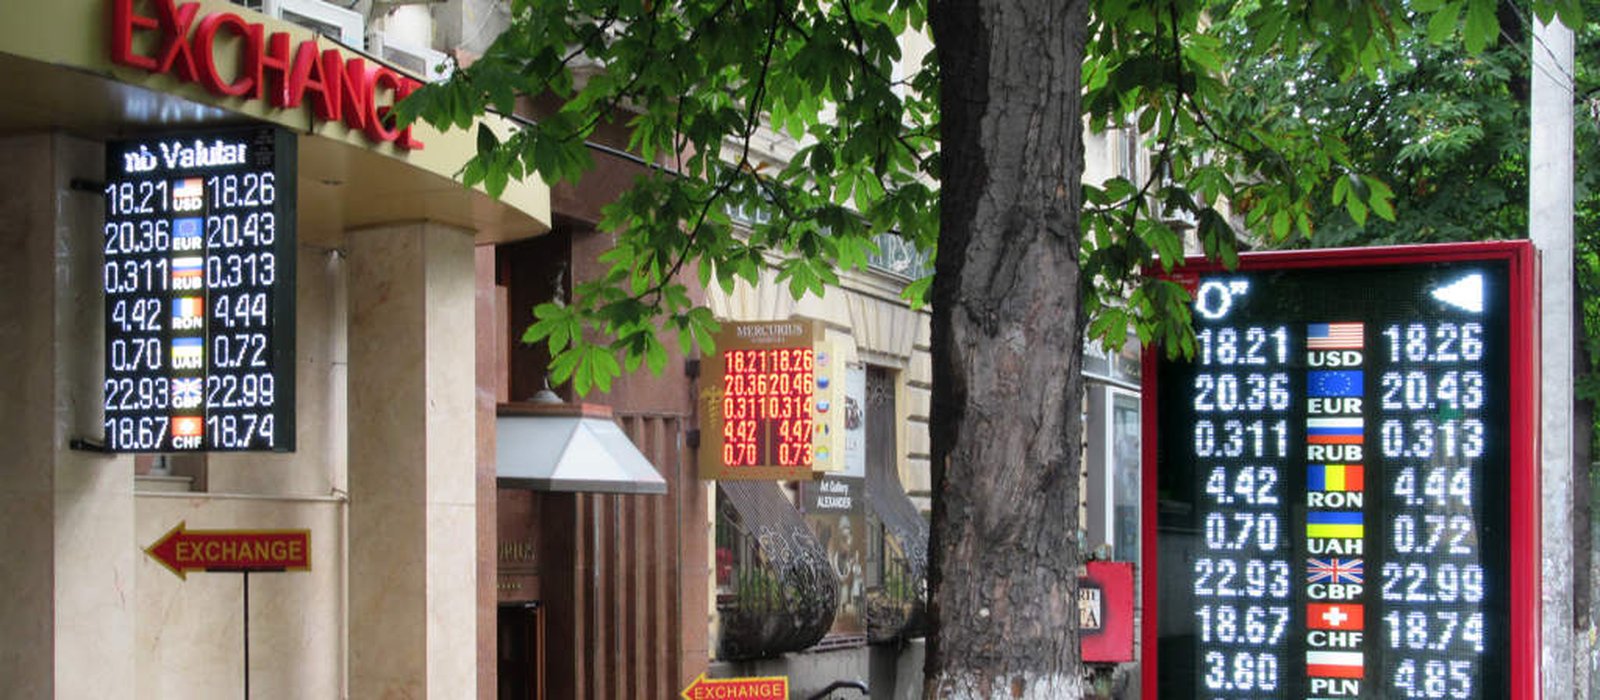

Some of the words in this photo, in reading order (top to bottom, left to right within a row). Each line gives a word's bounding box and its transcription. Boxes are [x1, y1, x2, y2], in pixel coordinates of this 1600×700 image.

[104, 180, 168, 215] 18.21
[173, 197, 202, 211] USD
[207, 172, 275, 209] 18.26
[104, 219, 169, 255] 20.36
[173, 237, 202, 250] EUR
[207, 212, 275, 248] 20.43
[104, 258, 168, 293] 0.311
[172, 276, 202, 290] RUB
[206, 252, 275, 289] 0.313
[112, 299, 162, 332] 4.42
[172, 316, 202, 329] RON
[214, 293, 267, 327] 4.44
[111, 338, 162, 371] 0.70
[214, 334, 267, 367] 0.72
[724, 351, 767, 373] 18.21
[770, 350, 813, 372] 18.26
[1196, 327, 1287, 364] 18.21
[1307, 351, 1363, 366] USD
[1382, 323, 1483, 362] 18.26
[104, 377, 168, 410] 22.93
[206, 373, 274, 407] 22.99
[724, 375, 767, 396] 20.36
[769, 373, 813, 394] 20.46
[1195, 373, 1289, 411] 20.36
[1307, 398, 1363, 413] EUR
[1382, 370, 1483, 409] 20.43
[724, 398, 766, 419] 0.311
[769, 397, 813, 418] 0.314
[104, 416, 169, 450] 18.67
[172, 436, 202, 449] CHF
[207, 414, 274, 447] 18.74
[724, 421, 757, 442] 4.42
[779, 420, 813, 441] 4.47
[1195, 419, 1287, 457] 0.311
[1307, 445, 1363, 461] RUB
[1382, 419, 1483, 458] 0.313
[724, 444, 757, 465] 0.70
[779, 443, 813, 465] 0.73
[1205, 466, 1278, 504] 4.42
[1307, 492, 1363, 507] RON
[1393, 466, 1472, 505] 4.44
[175, 541, 303, 561] EXCHANGE
[1205, 512, 1278, 550] 0.70
[1307, 539, 1363, 554] UAH
[1393, 514, 1472, 553] 0.72
[1195, 559, 1289, 597] 22.93
[1307, 585, 1363, 600] GBP
[1382, 562, 1483, 602] 22.99
[1195, 605, 1289, 643] 18.67
[1307, 631, 1363, 647] CHF
[1382, 611, 1484, 651] 18.74
[694, 683, 782, 700] EXCHANGE
[1205, 651, 1278, 690] 3.80
[1310, 679, 1359, 695] PLN
[1393, 658, 1472, 699] 4.85
